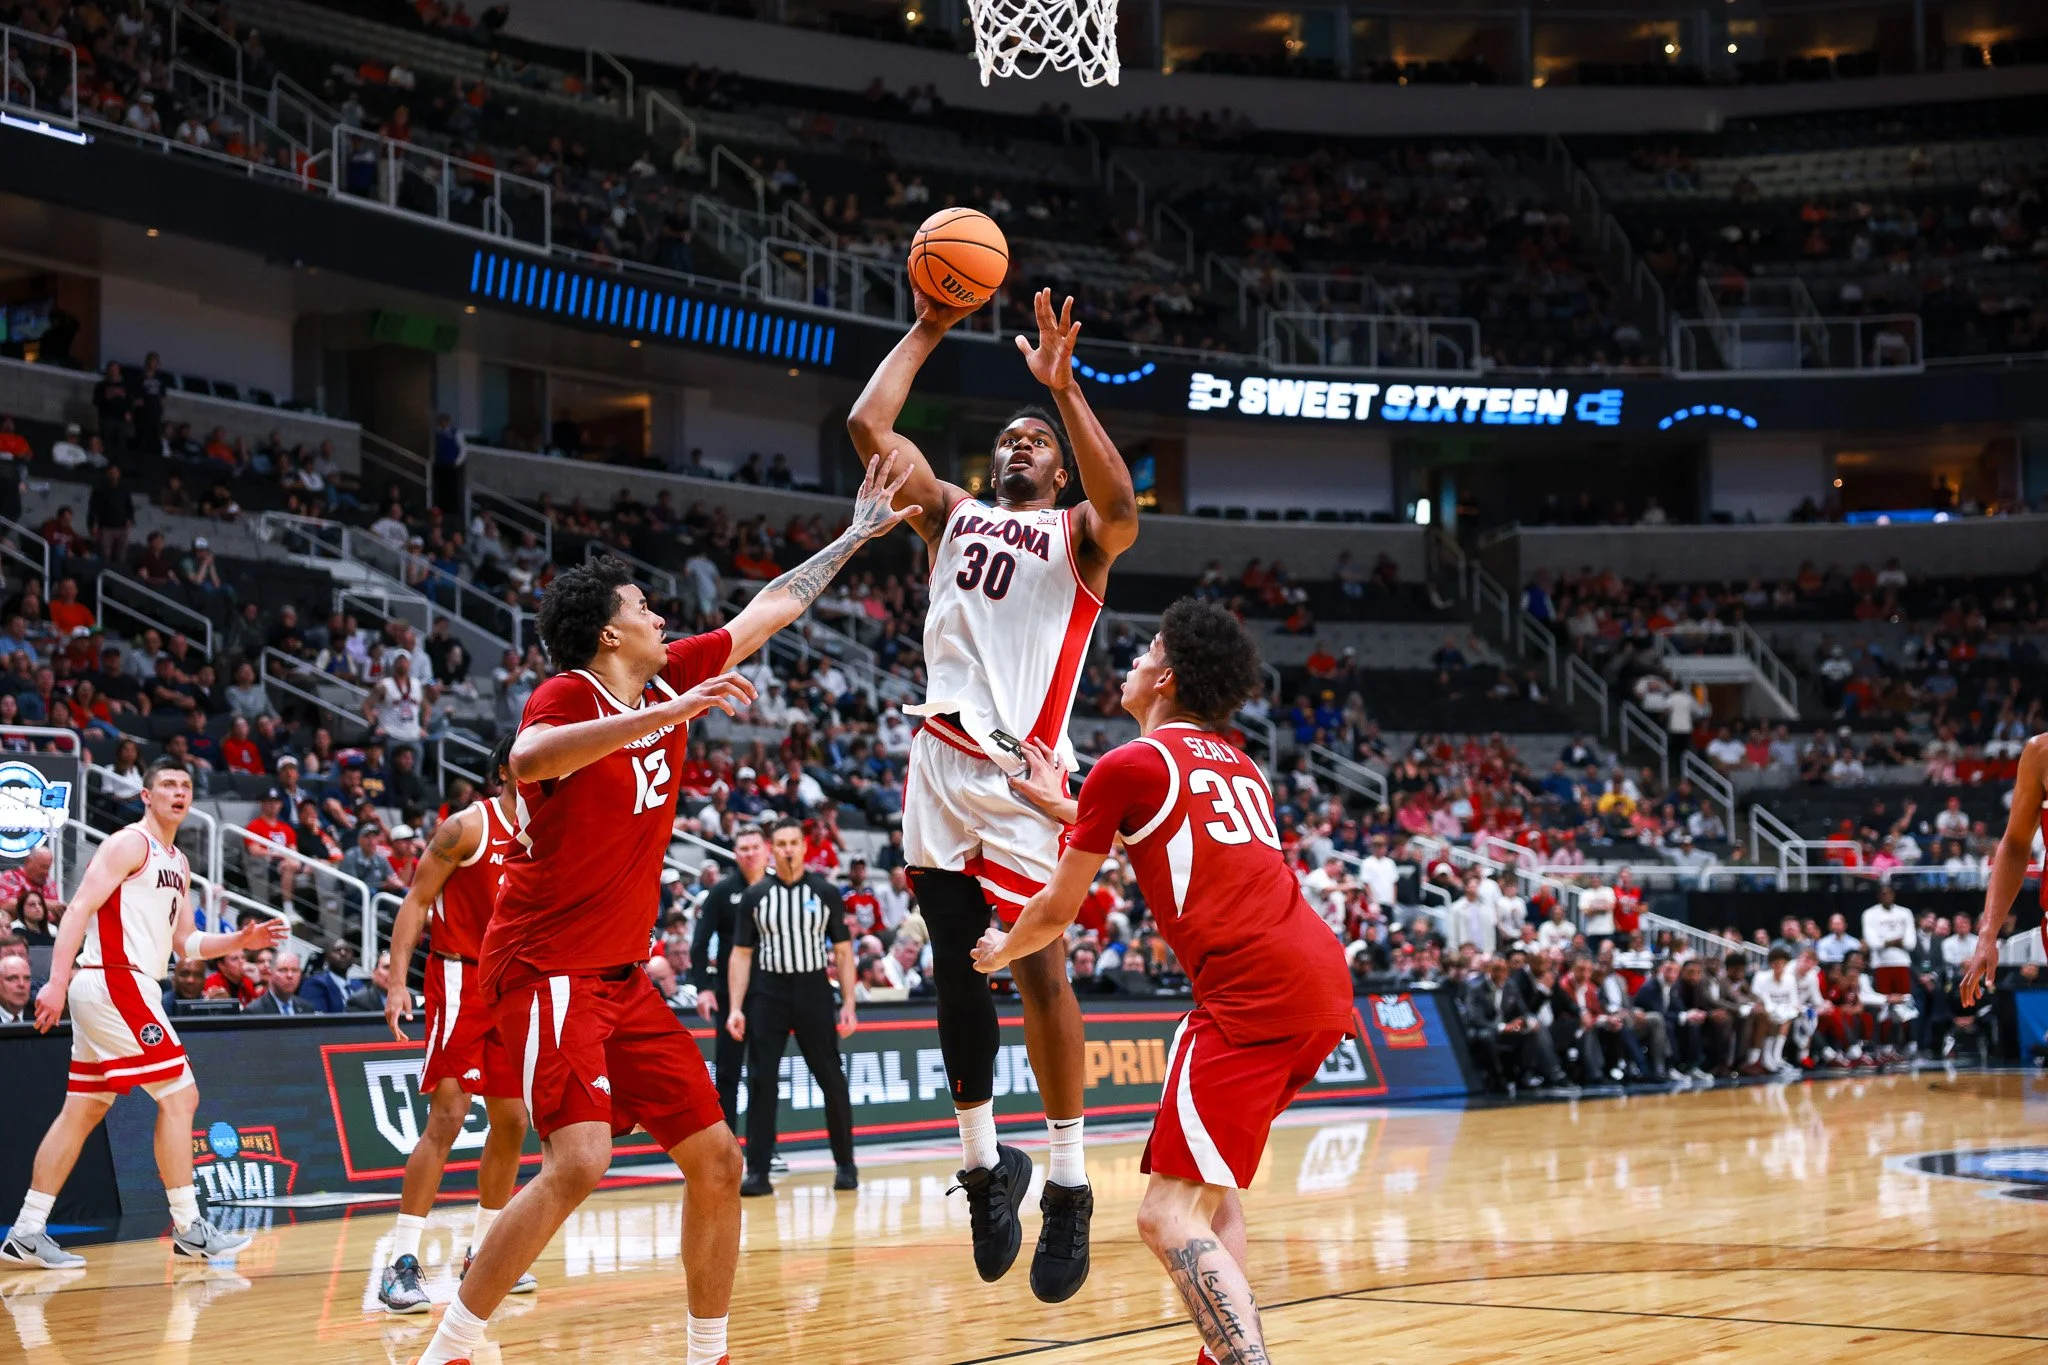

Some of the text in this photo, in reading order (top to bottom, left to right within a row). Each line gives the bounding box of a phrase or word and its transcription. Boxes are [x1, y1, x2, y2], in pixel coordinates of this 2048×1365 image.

[1238, 377, 1569, 425] SWEET SIXTEEN
[949, 515, 1050, 562] ARIZONA
[956, 542, 1016, 600] 30
[1182, 736, 1240, 764] SEALY
[631, 748, 671, 815] 12
[1188, 768, 1282, 852] 30
[916, 1045, 1041, 1100] FUR
[1083, 1038, 1167, 1089] PRIL
[1201, 1270, 1245, 1339] ISAIAH
